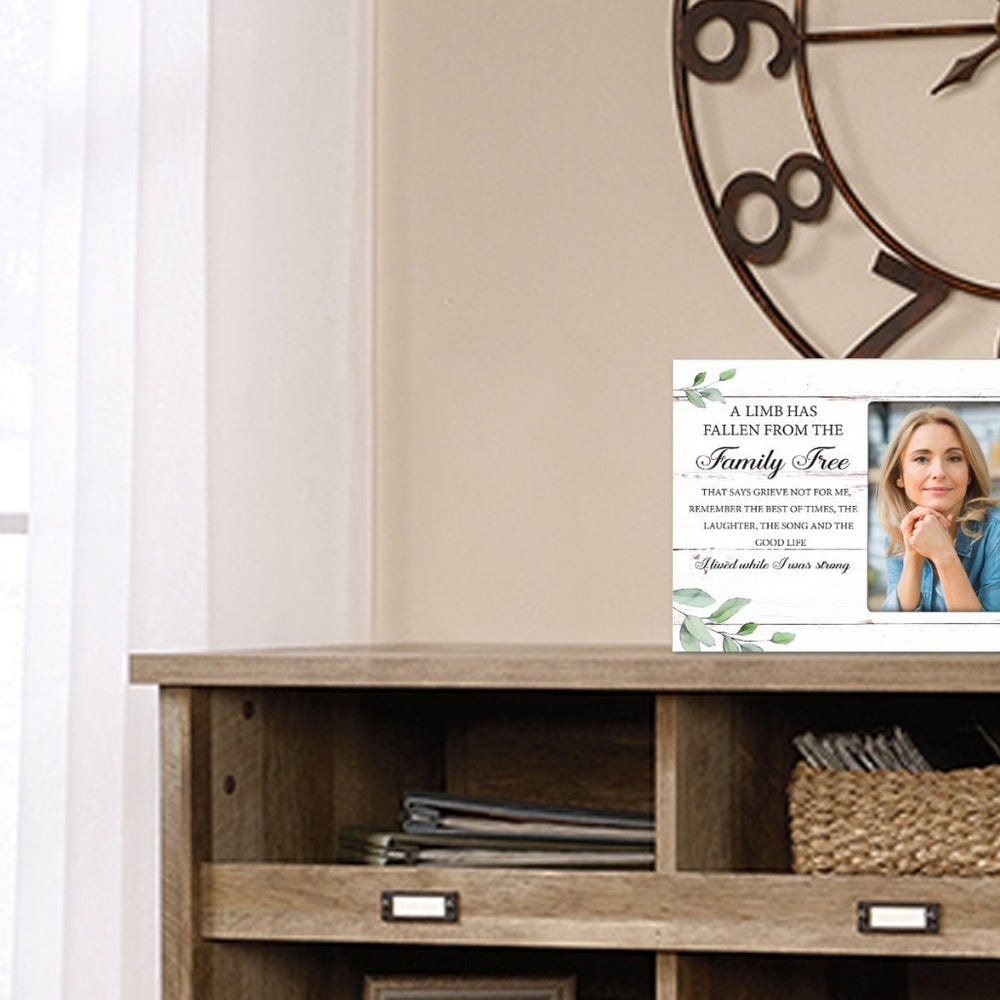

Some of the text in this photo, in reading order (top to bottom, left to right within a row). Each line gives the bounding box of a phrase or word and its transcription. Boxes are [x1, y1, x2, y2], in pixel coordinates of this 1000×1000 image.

[720, 153, 833, 265] 8
[848, 249, 950, 358] 7
[729, 405, 818, 417] A LIMB HAS
[703, 424, 844, 436] FALLEN FROM THE
[695, 445, 851, 480] Family Tree
[701, 488, 852, 497] THAT SAYS GRIEVE NOT FOR ME,
[688, 505, 858, 514] REMEMBER THE BEST OF TIMES, THE
[703, 522, 854, 531] LAUGHTER, THE SONG AND THE
[754, 538, 807, 547] GOOD LIFE
[695, 556, 851, 575] I lived while I was strong
